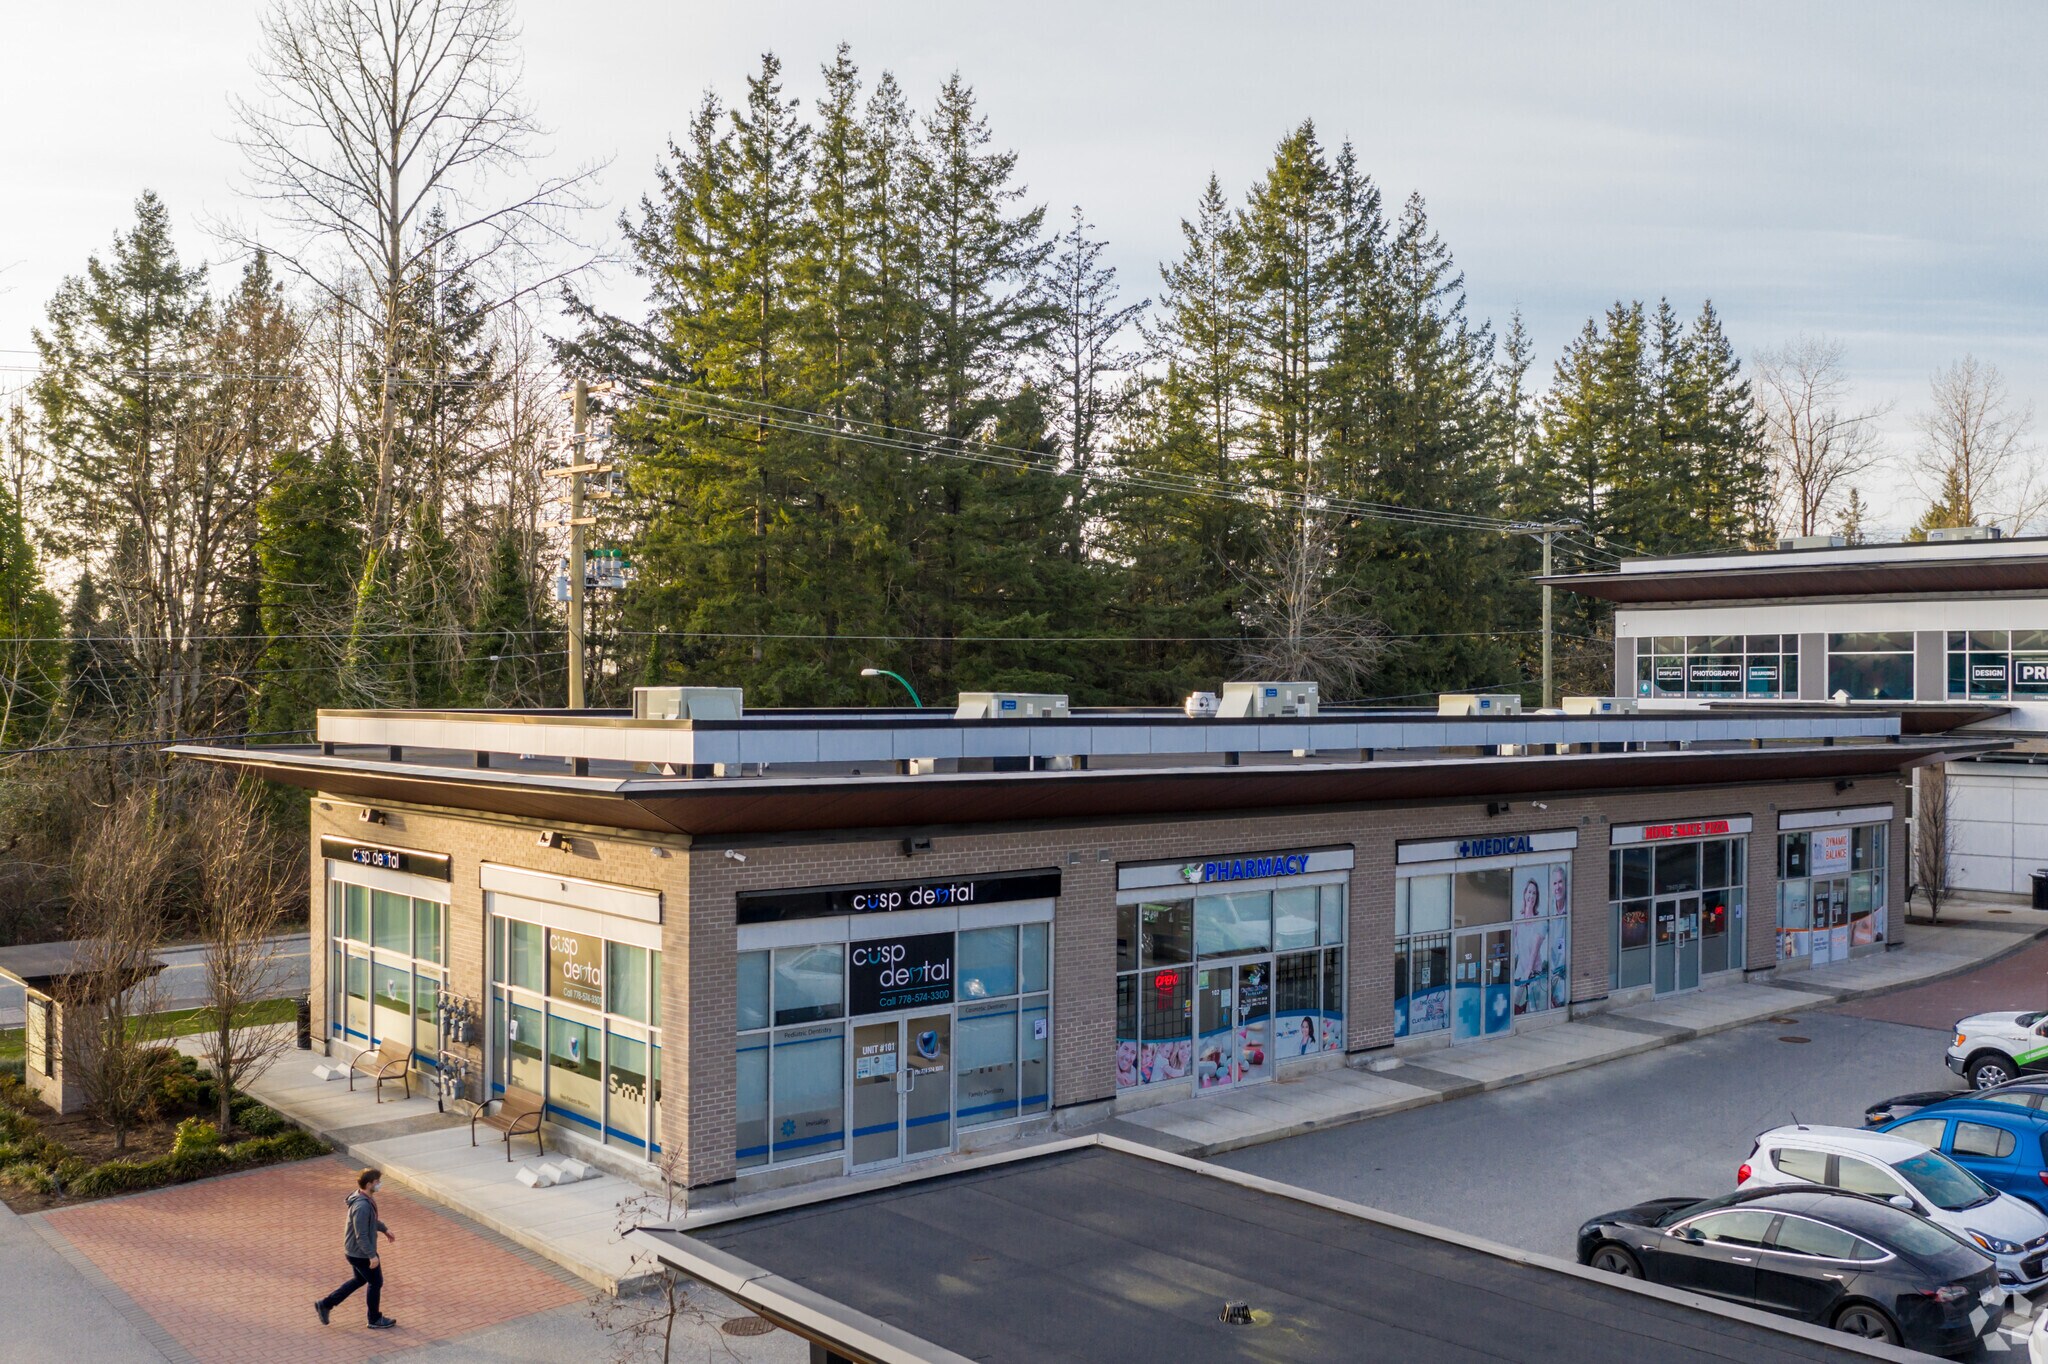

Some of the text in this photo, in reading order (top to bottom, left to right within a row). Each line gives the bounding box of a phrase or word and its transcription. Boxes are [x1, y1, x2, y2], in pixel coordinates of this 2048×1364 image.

[1692, 669, 1739, 677] PHOTOGRAPHY
[1975, 669, 2003, 677] DESIGN
[1472, 835, 1534, 857] MEDICAL
[1825, 835, 1847, 848] DYNAMIC
[1825, 848, 1847, 860] BALANCE
[1204, 854, 1310, 882] PHARMACY
[909, 882, 974, 905] dental
[563, 960, 602, 986] denta
[880, 958, 950, 987] dental
[880, 990, 950, 1007] Call 778-574-3300
[862, 1042, 895, 1055] UNIT #101
